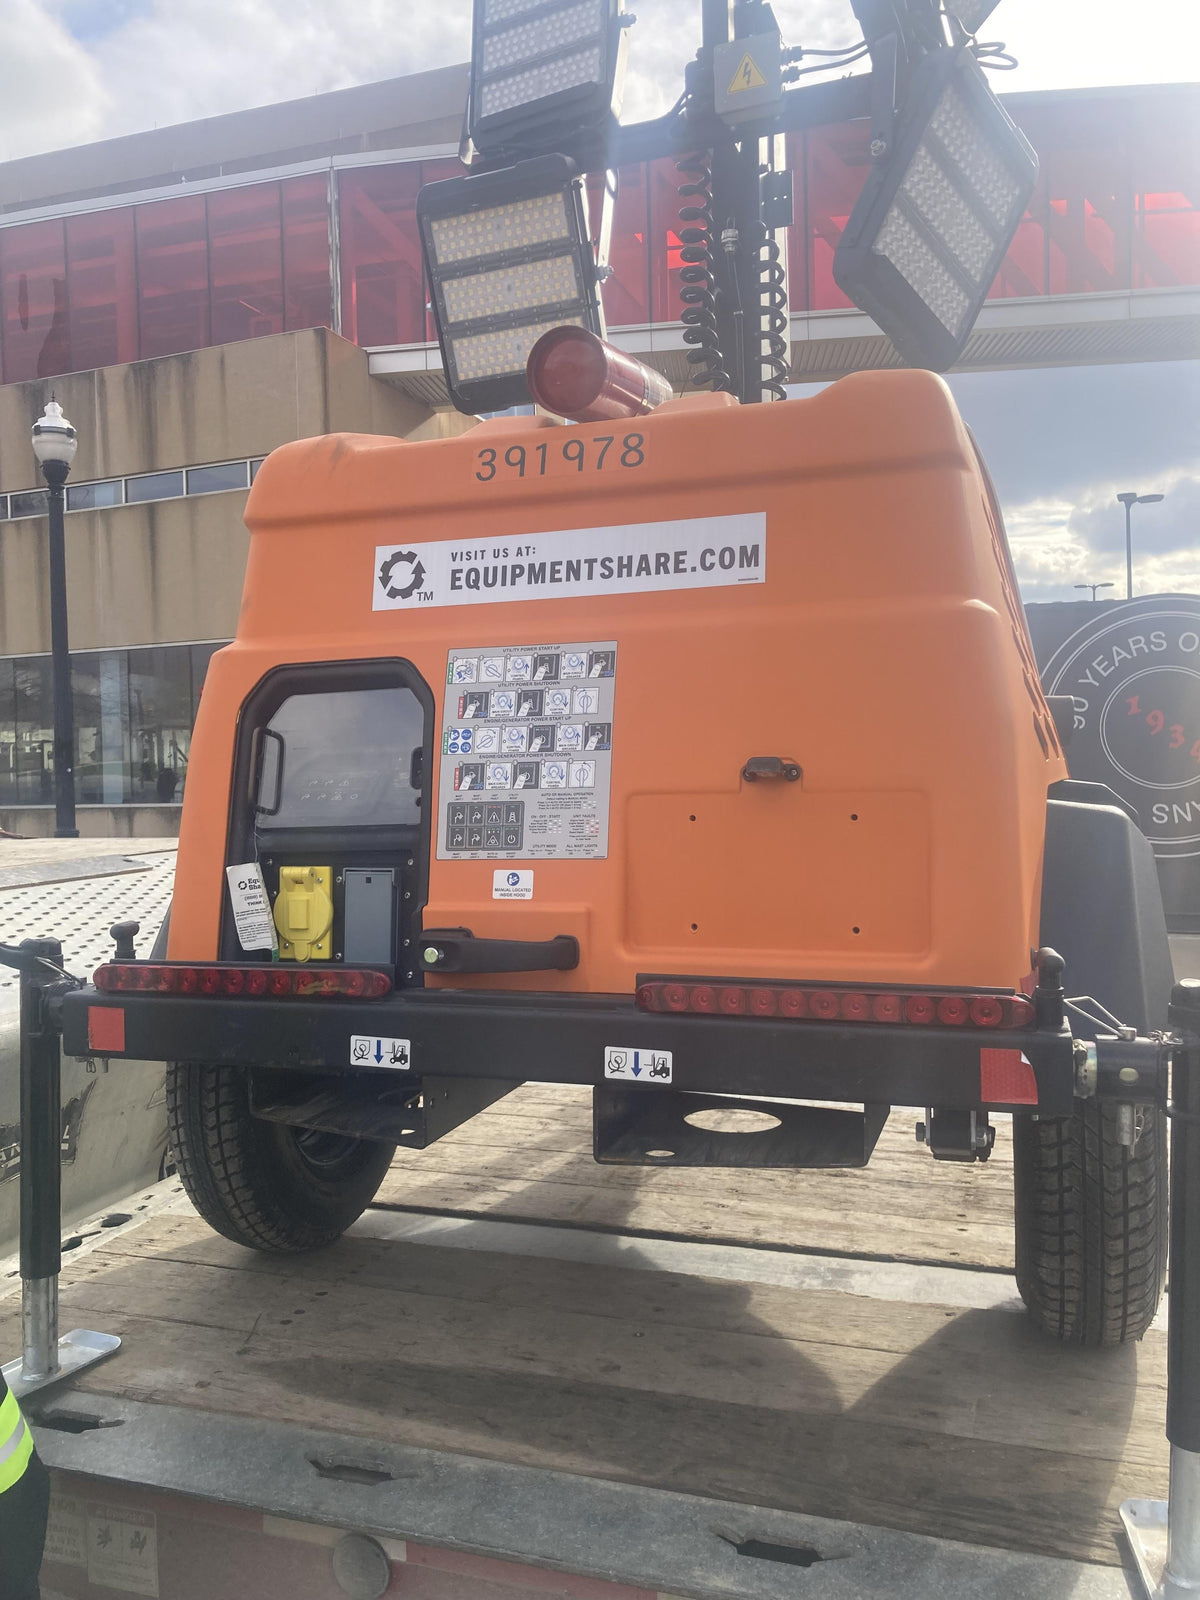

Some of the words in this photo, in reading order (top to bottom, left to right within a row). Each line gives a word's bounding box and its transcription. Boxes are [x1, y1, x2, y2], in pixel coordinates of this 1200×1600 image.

[475, 433, 645, 482] 391978
[450, 543, 760, 591] EQUIPMENTSHARE.COM
[451, 550, 486, 562] VISIT
[493, 547, 509, 559] US
[516, 545, 537, 557] AT:
[417, 591, 434, 602] TM
[1078, 631, 1167, 688] YEARS
[1178, 632, 1200, 654] O
